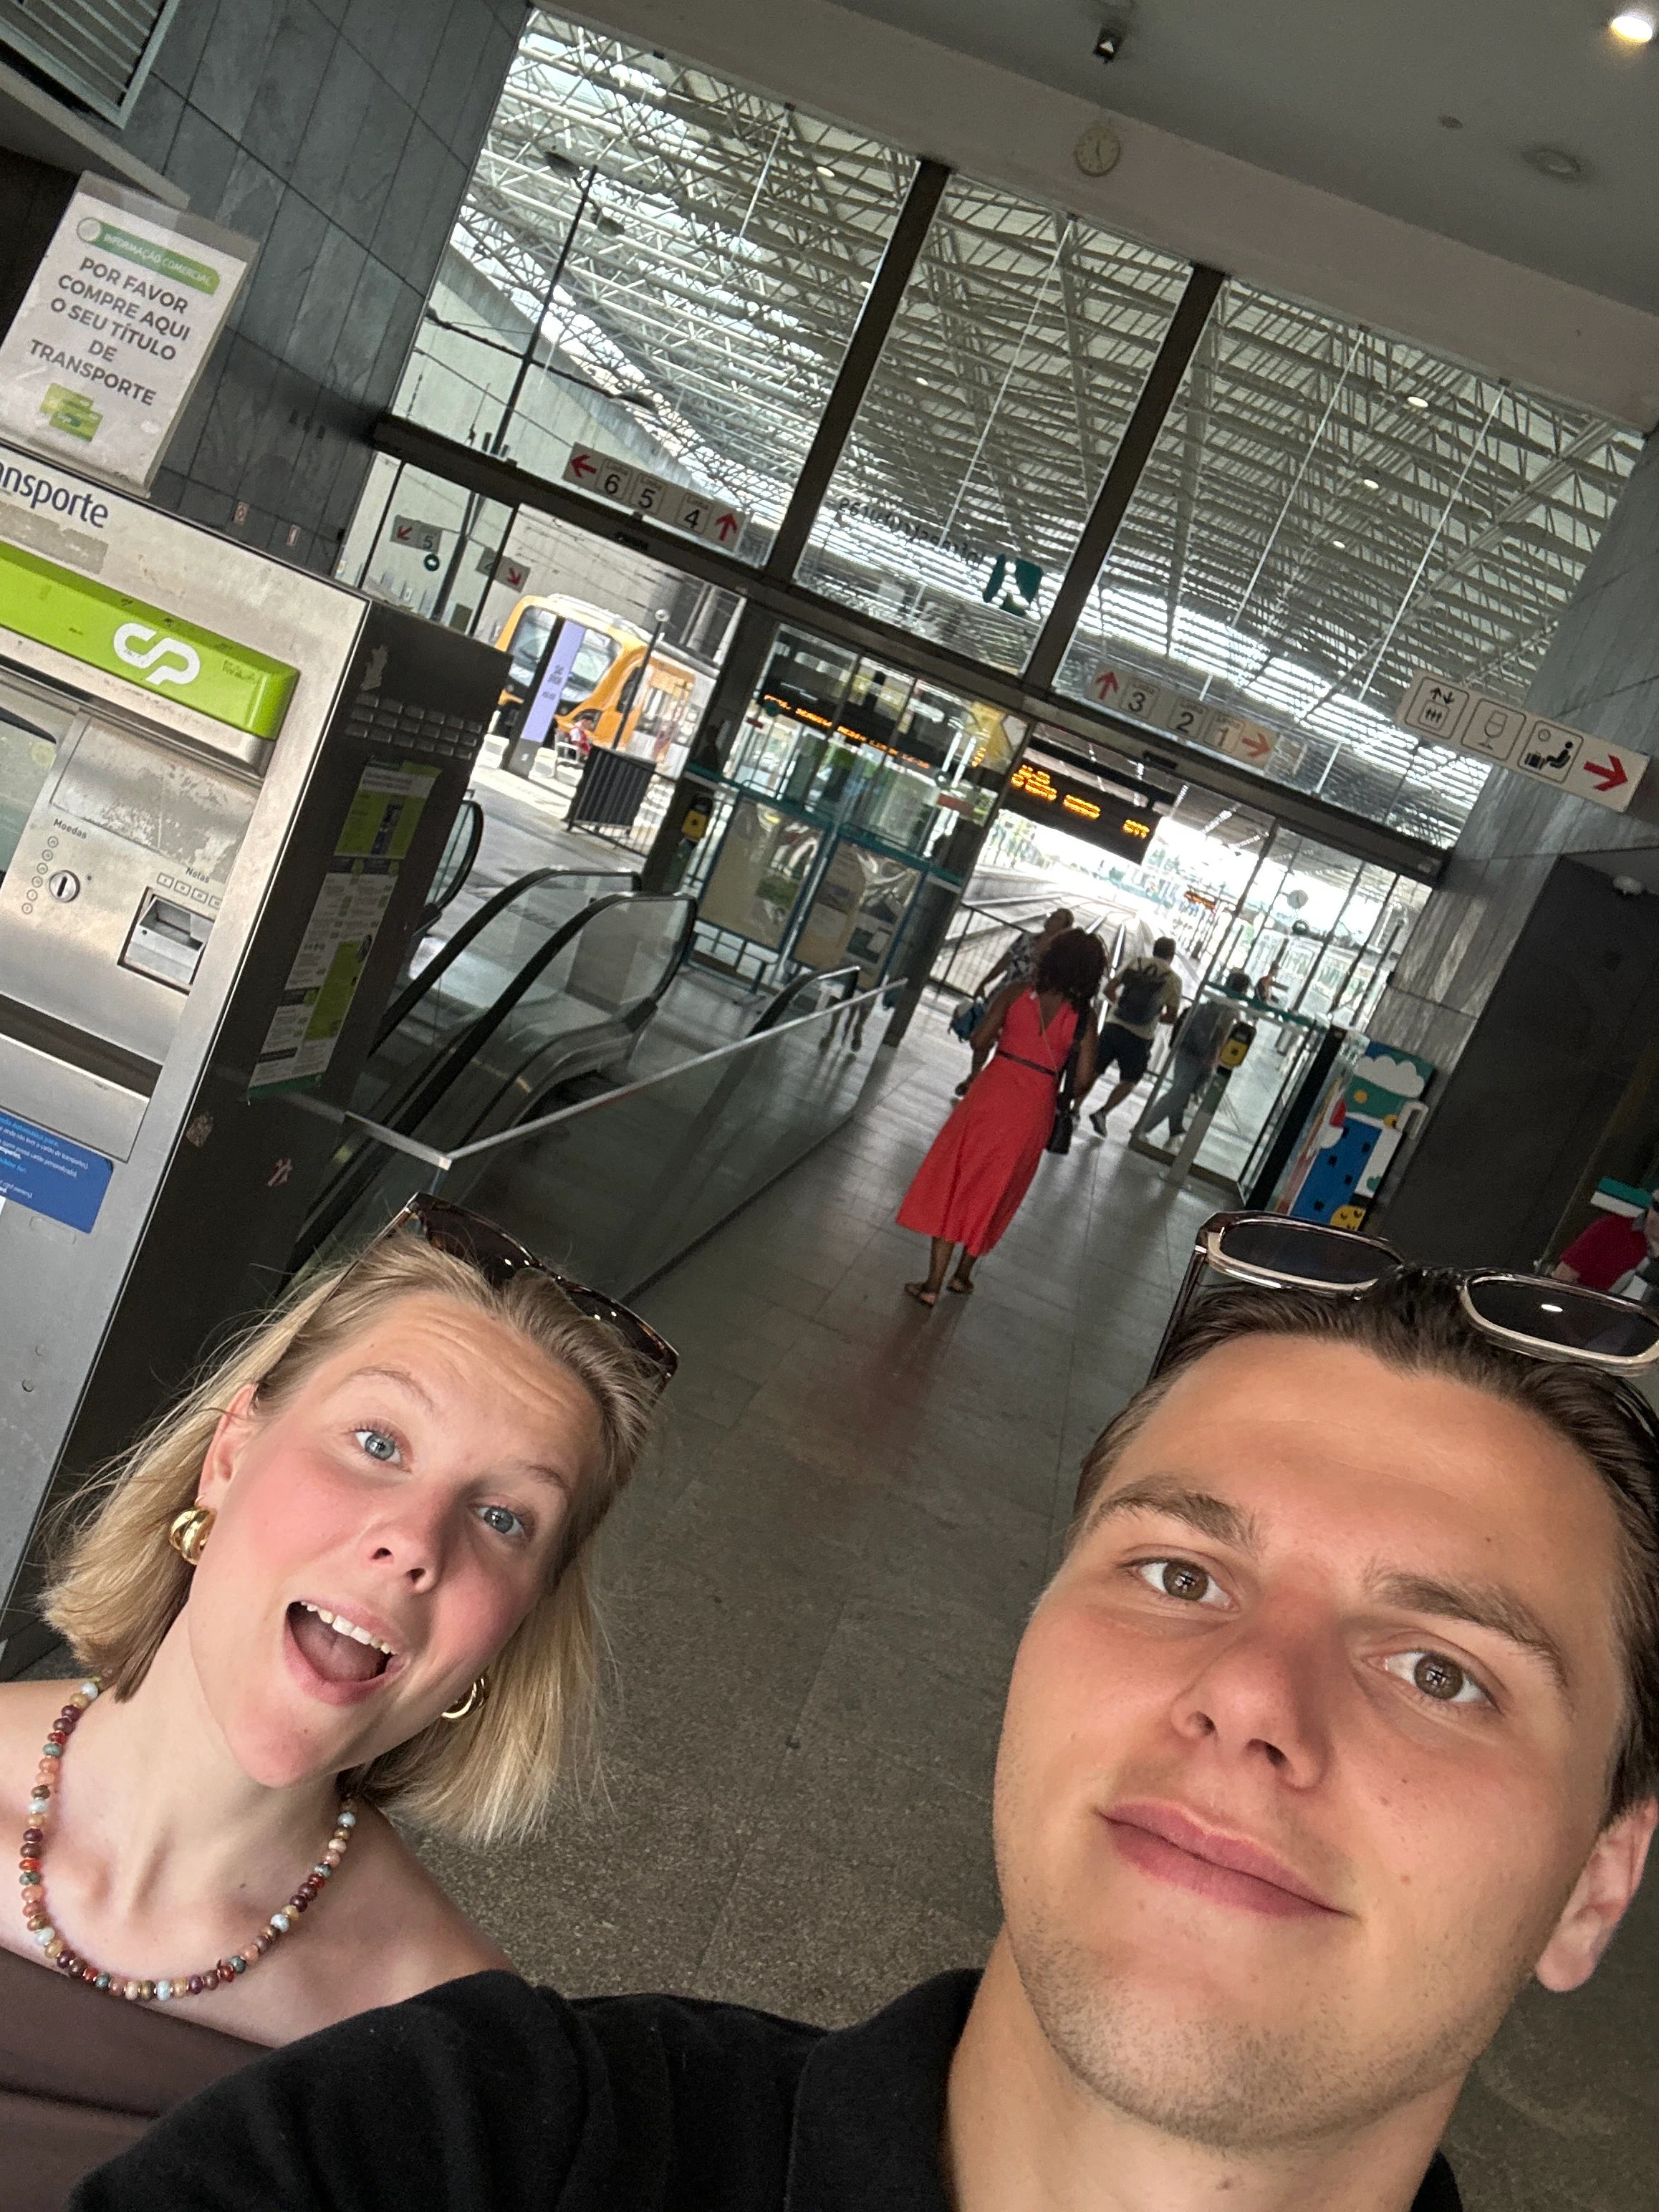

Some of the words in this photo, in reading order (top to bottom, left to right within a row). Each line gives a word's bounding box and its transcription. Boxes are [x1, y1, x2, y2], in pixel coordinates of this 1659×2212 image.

[80, 256, 121, 285] POR
[122, 276, 189, 314] FAVOR
[58, 274, 140, 318] COMPRE
[140, 312, 191, 341] AQUI
[50, 297, 65, 313] O
[67, 304, 105, 331] SEU
[112, 320, 177, 360] TÍTULO
[88, 340, 117, 362] DE
[29, 339, 157, 406] TRANSPORTE
[605, 473, 621, 494] 6
[638, 488, 655, 509] 5
[684, 509, 700, 529] 4
[112, 622, 201, 685] CP
[1127, 691, 1145, 713] 3
[1176, 711, 1196, 733] 2
[1215, 726, 1228, 746] 1
[53, 818, 87, 840] Moedas
[186, 867, 210, 884] Notas
